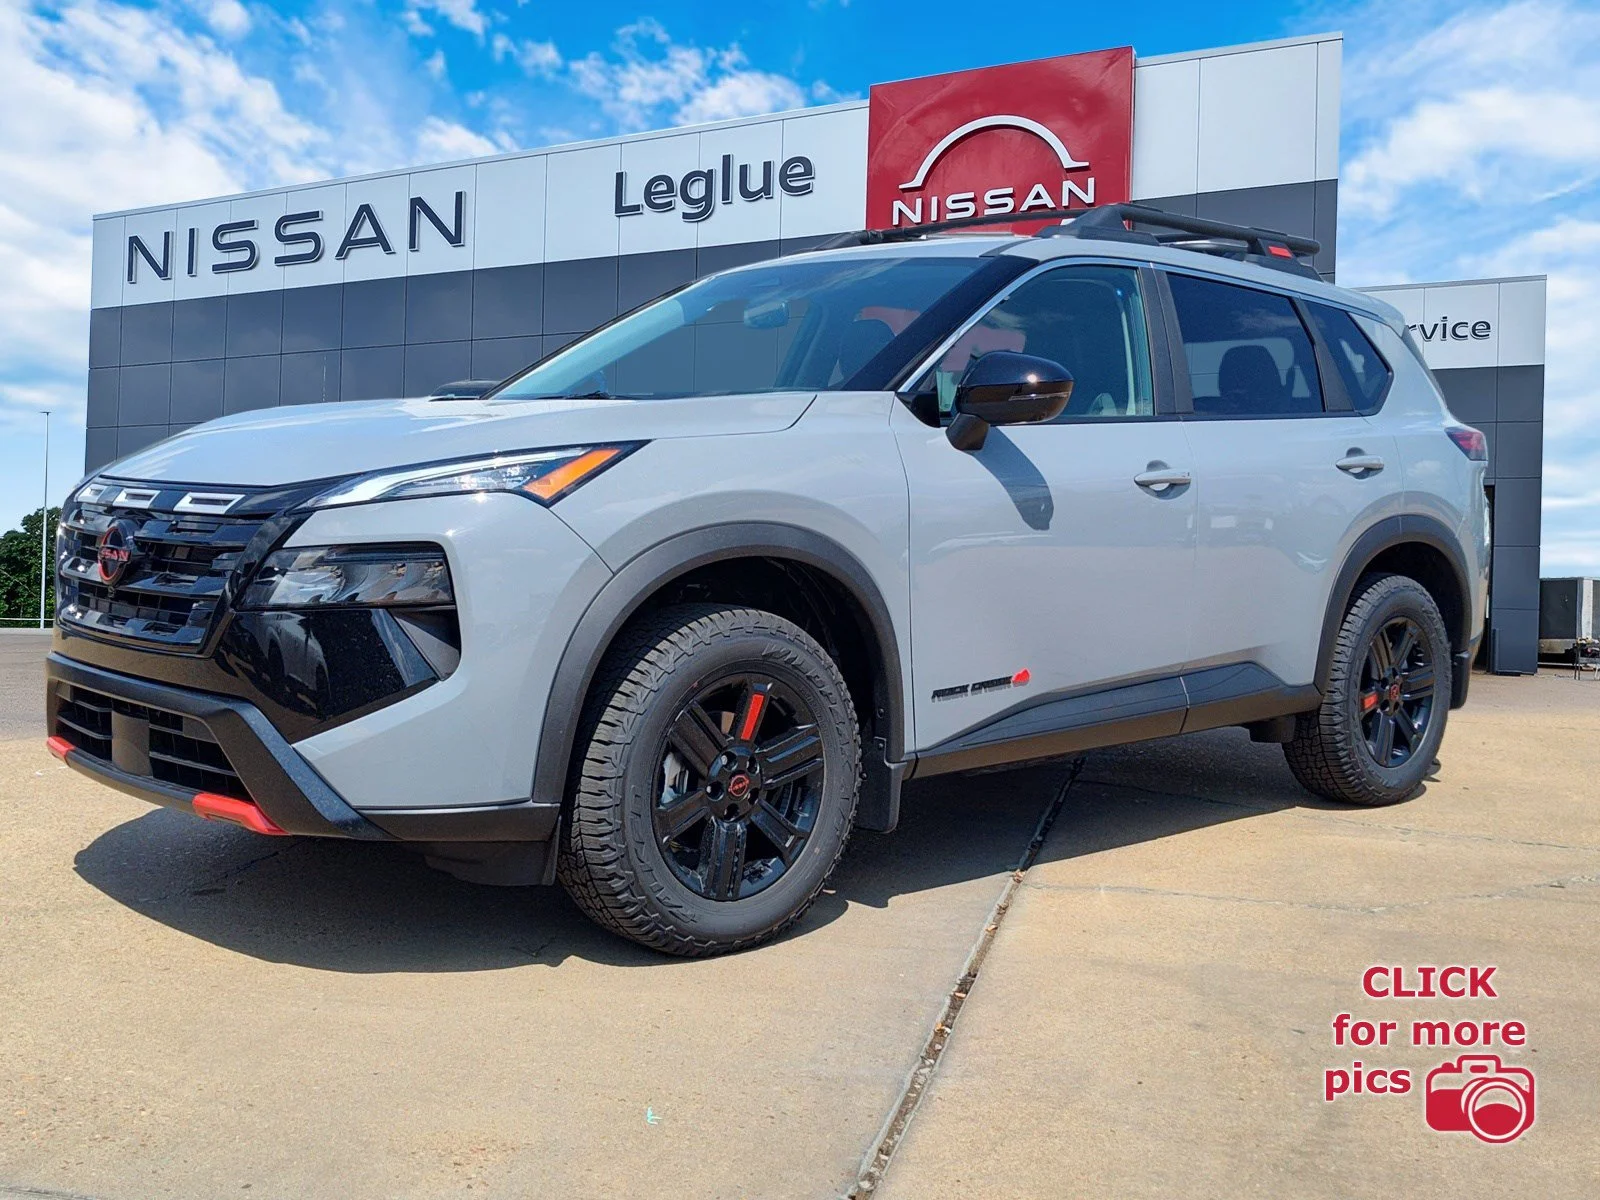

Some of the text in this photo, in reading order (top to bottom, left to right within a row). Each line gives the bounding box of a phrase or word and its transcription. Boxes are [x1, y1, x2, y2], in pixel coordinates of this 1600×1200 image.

[614, 153, 815, 221] Leglue
[892, 177, 1095, 226] NISSAN
[127, 191, 465, 284] NISSAN
